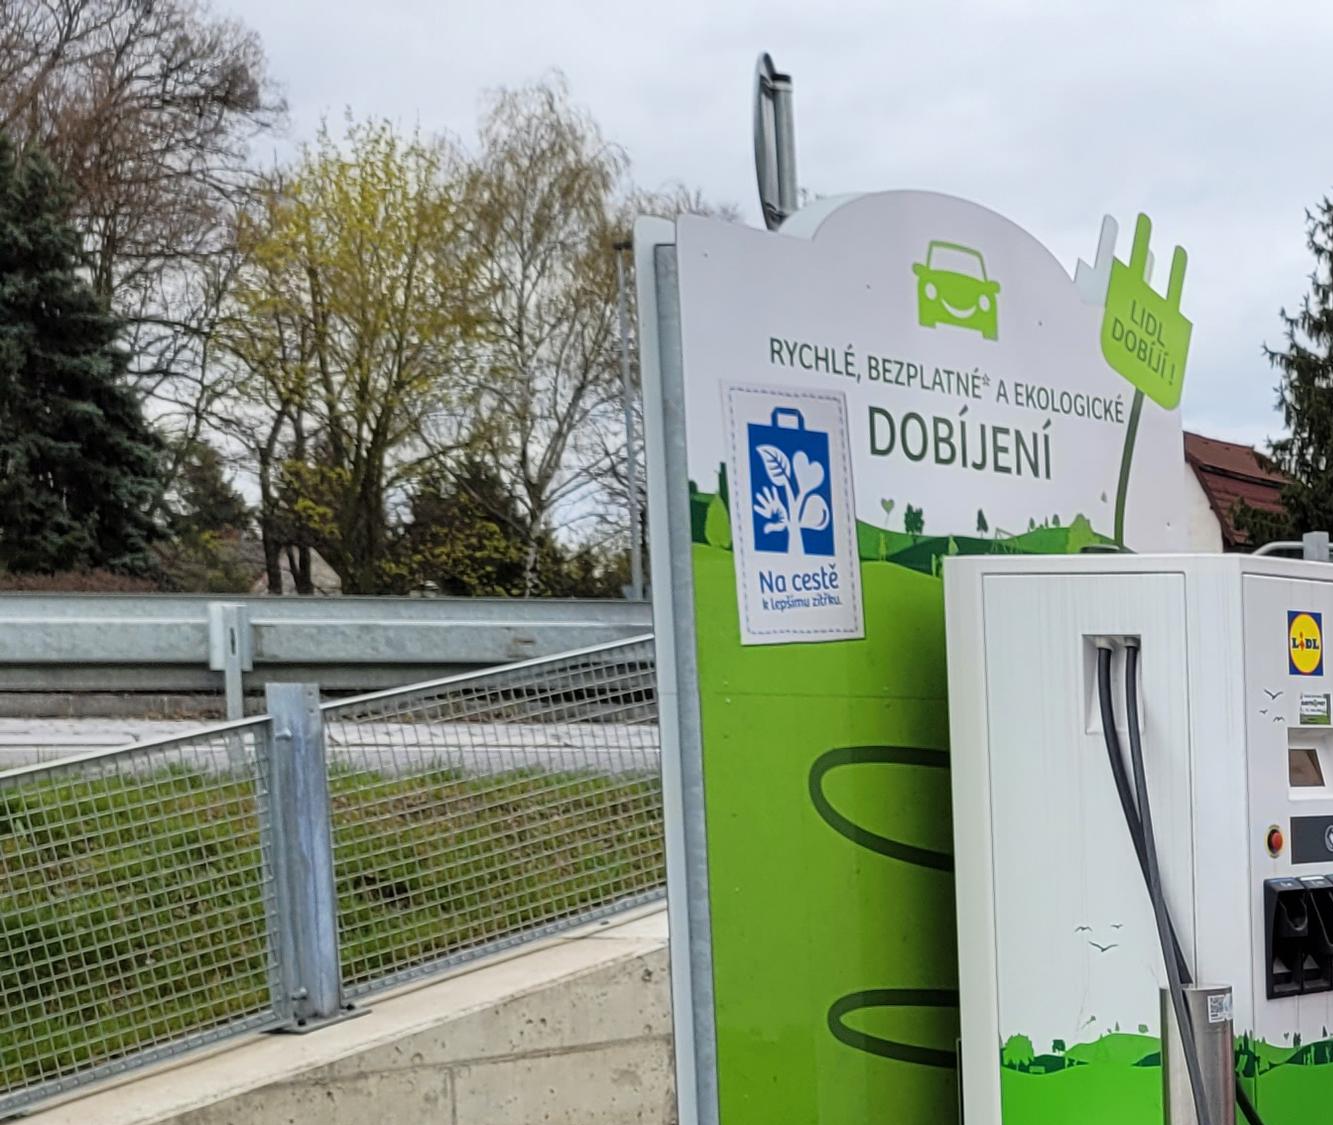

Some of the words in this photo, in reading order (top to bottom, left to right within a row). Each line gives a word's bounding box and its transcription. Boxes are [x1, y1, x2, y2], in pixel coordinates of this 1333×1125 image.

[1131, 299, 1165, 349] LIDL
[769, 336, 861, 384] RYCHLÉ,
[996, 379, 1010, 405] A
[1014, 381, 1125, 424] EKOLOGICKÉ
[868, 403, 1052, 480] DOBÍJENÍ
[759, 570, 787, 594] Na
[791, 562, 840, 592] cestě
[1291, 632, 1320, 651] LIDL
